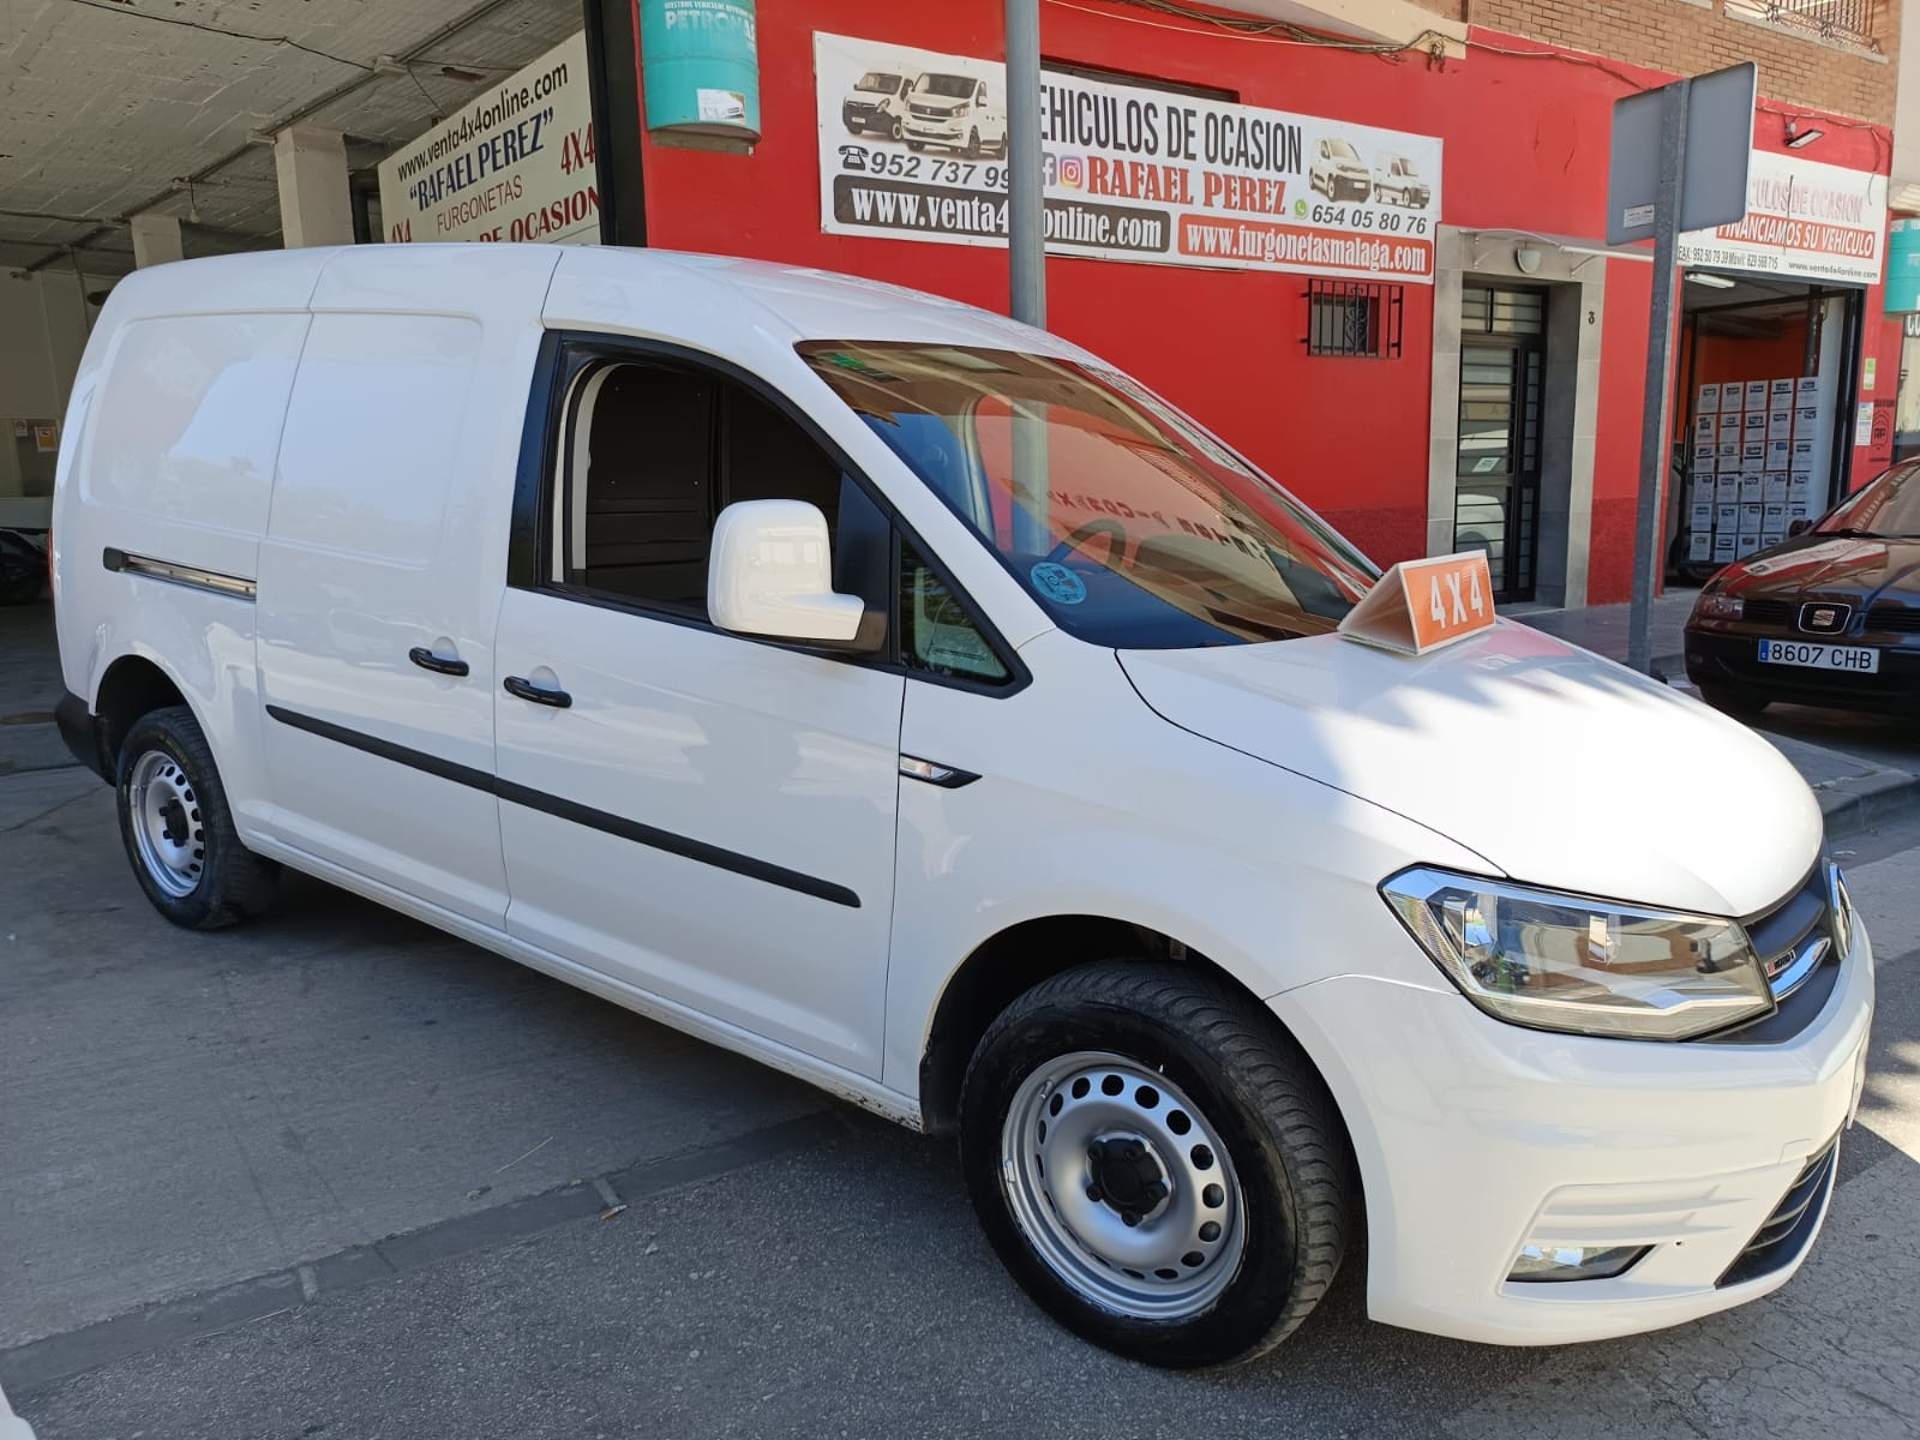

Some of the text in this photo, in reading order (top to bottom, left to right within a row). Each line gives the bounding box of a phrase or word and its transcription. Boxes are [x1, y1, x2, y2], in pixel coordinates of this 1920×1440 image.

[397, 63, 568, 182] www.venta4x4online.com
[560, 123, 596, 175] 4X4
[1041, 84, 1302, 175] EHICULOS DE OCASION
[870, 152, 922, 179] 952
[930, 159, 978, 185] 737
[1087, 155, 1287, 215] RAFAEL PEREZ
[437, 175, 523, 236] FURGONETAS
[510, 186, 600, 242] OCASION
[851, 187, 1161, 249] www.venta4online.com
[1312, 204, 1427, 234] 654 05 80 76
[1186, 223, 1425, 272] www.furgonetasmalaga.com
[1803, 223, 1820, 250] SU
[1821, 225, 1874, 257] VEHICULO
[1430, 566, 1484, 629] 4X4
[1771, 643, 1824, 664] 8607
[1831, 648, 1872, 669] CHB
